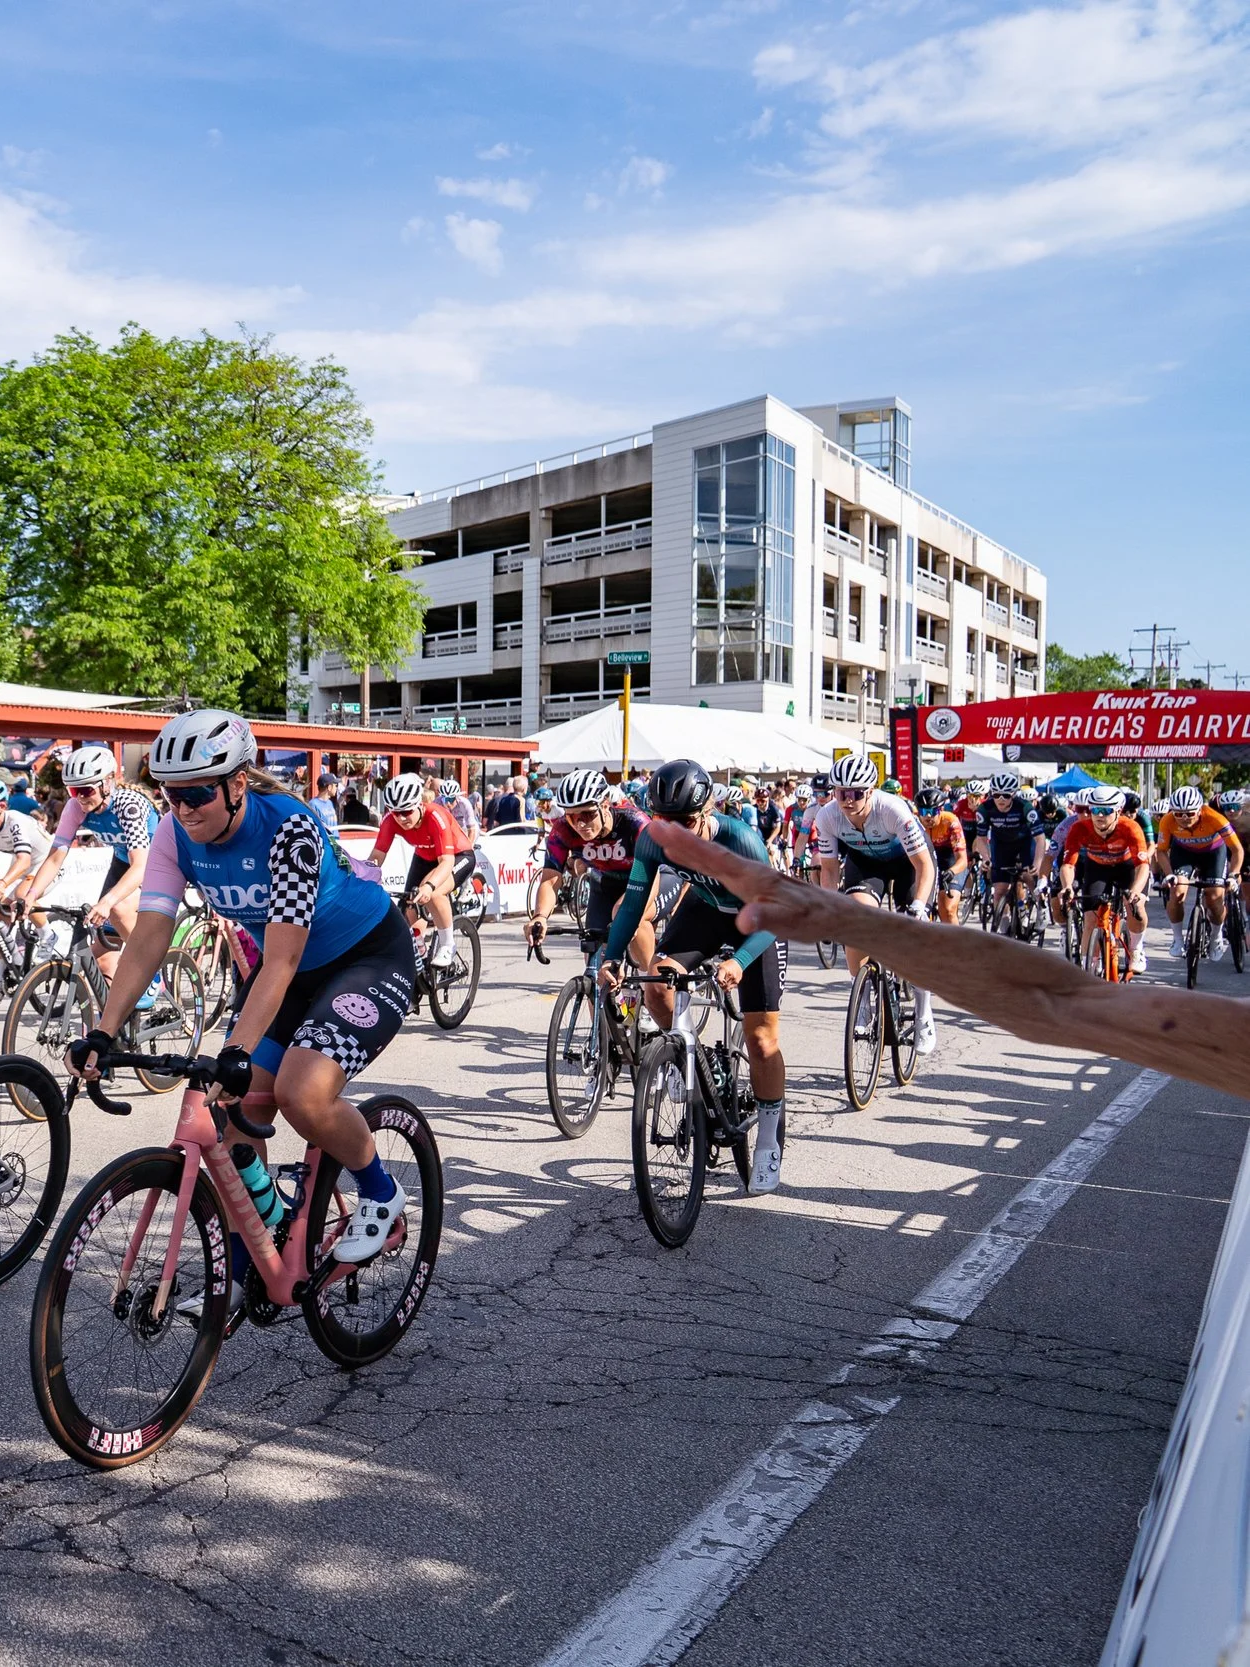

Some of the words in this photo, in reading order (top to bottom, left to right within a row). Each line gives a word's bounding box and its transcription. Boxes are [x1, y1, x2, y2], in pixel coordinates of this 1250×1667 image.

[613, 653, 642, 663] Belleview
[986, 716, 1013, 728] TOUR
[1011, 712, 1146, 740] AMERICA'S
[199, 719, 244, 761] KENETIX
[996, 728, 1010, 740] OF
[1107, 744, 1142, 758] NATIONAL
[1143, 744, 1206, 758] CHAMPIONSHIPS
[582, 839, 626, 861] 606
[192, 859, 221, 870] KENETIX
[197, 880, 271, 909] RDC
[335, 994, 353, 1003] RIDE
[379, 993, 406, 1022] VENTU
[335, 1006, 377, 1028] COLLECTIVE
